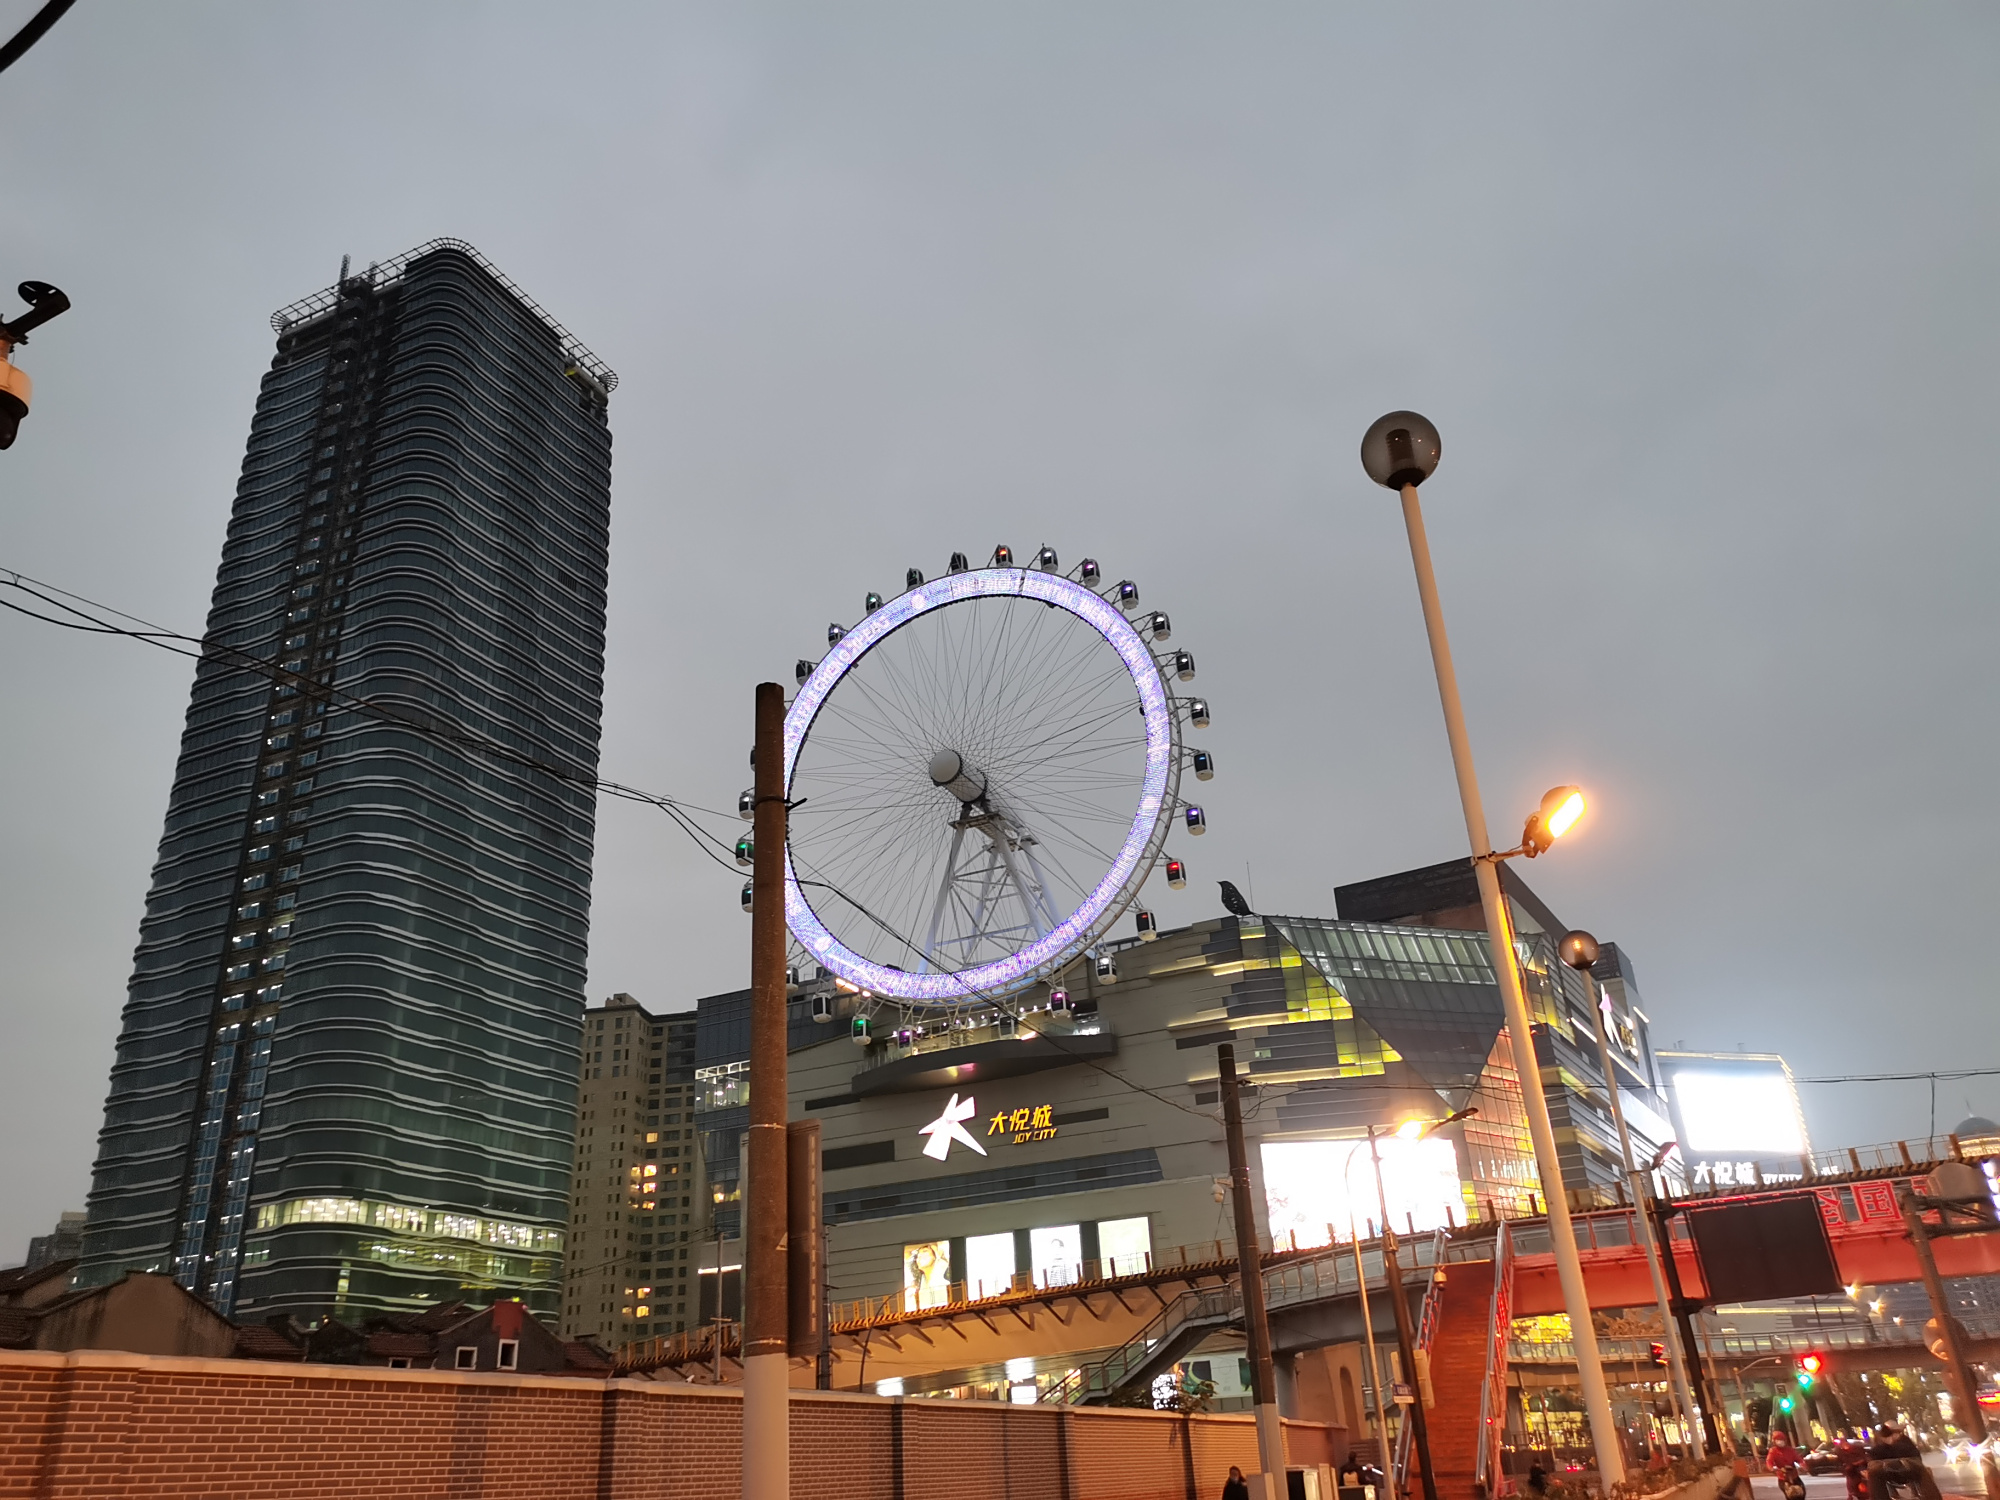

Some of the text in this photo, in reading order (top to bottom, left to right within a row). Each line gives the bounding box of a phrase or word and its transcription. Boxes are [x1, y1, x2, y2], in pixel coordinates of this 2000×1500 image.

[987, 1104, 1053, 1135] 大悦城
[1012, 1128, 1057, 1144] JOY CITY
[1693, 1160, 1757, 1185] 大悦城
